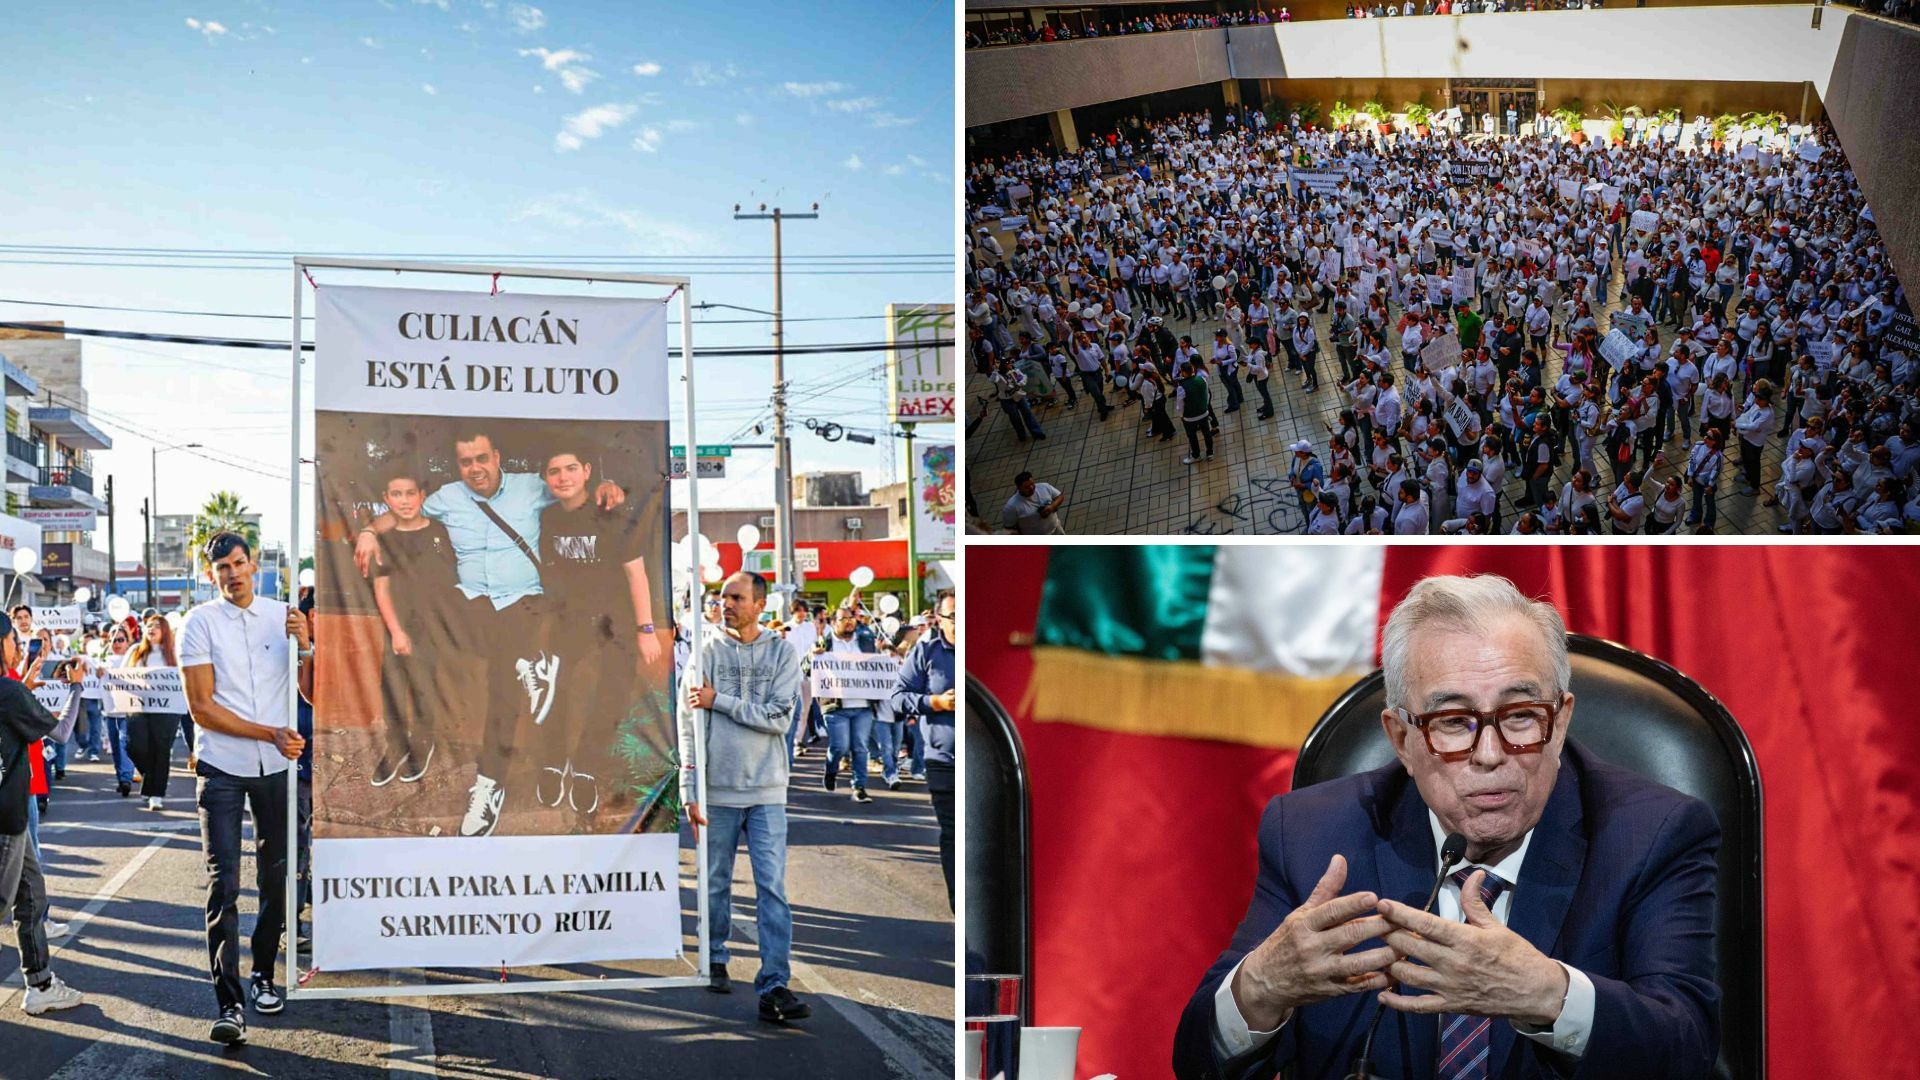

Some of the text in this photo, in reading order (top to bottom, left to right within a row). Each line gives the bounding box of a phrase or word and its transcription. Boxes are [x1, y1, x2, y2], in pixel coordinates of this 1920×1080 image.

[398, 310, 578, 345] CULIACÁN
[365, 356, 619, 396] ESTÁ DE LUTO
[130, 697, 170, 708] EN PAZ
[320, 870, 666, 904] JUSTICIA PARA LA FAMILIA
[379, 909, 612, 938] SARMIENTO RUIZ
